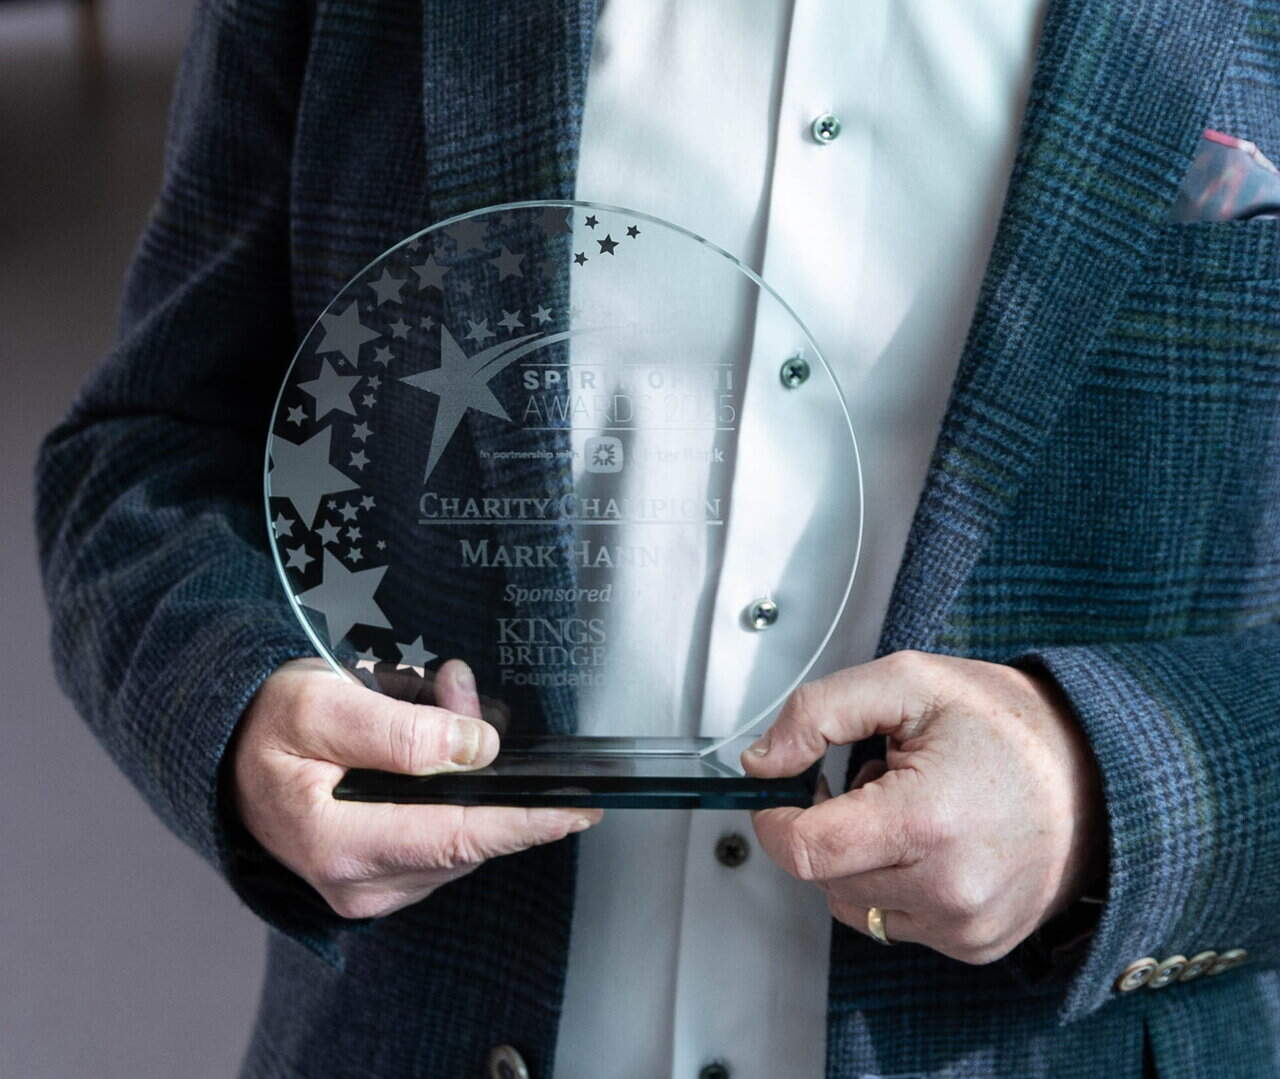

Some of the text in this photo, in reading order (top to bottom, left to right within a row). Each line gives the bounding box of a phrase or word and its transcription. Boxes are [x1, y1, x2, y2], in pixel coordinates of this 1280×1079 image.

[419, 492, 552, 519] CHARITY
[460, 539, 559, 568] MARK
[504, 584, 612, 606] Sponsored
[496, 618, 607, 645] KINGS
[499, 646, 607, 666] BRIDGE
